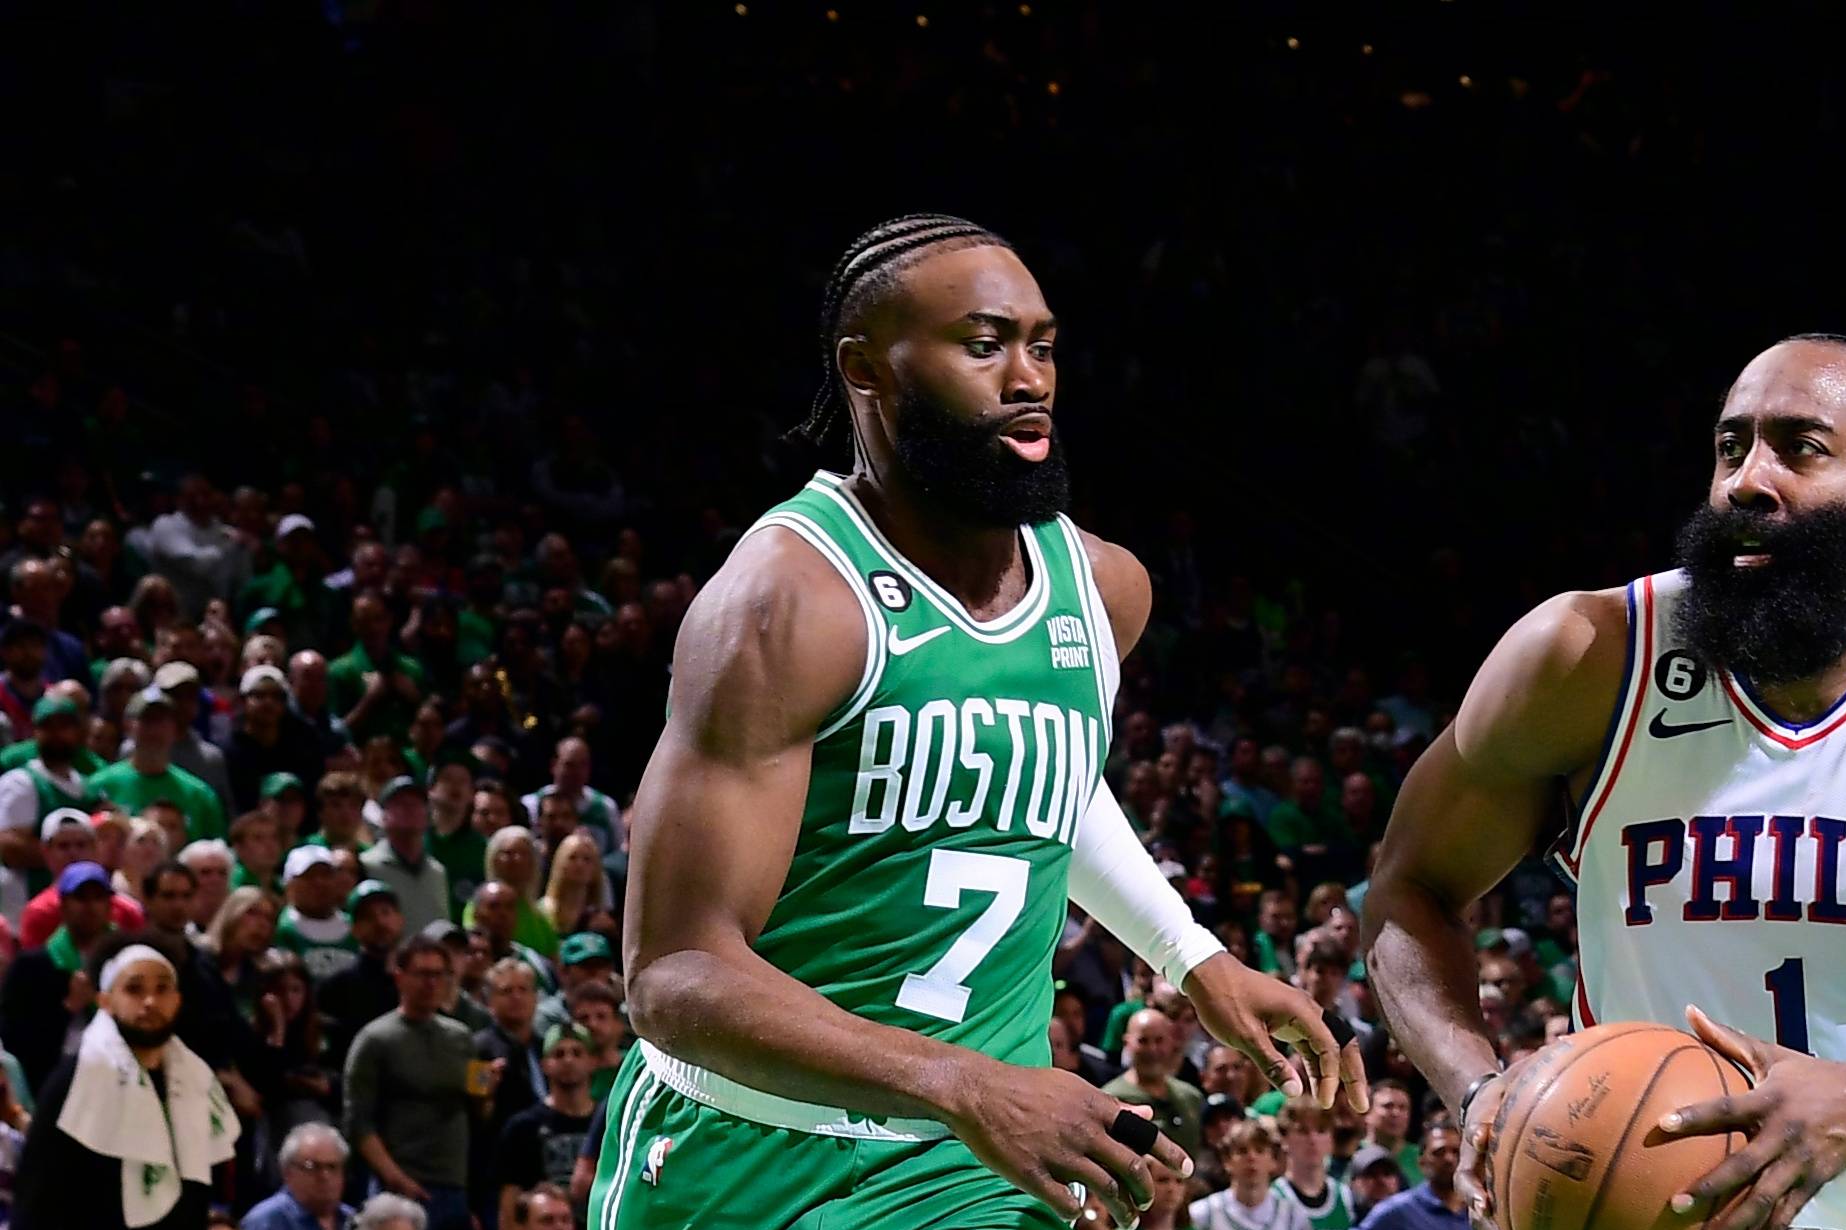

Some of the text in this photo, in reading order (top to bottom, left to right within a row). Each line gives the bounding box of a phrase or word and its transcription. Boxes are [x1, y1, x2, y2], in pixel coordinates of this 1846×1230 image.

[874, 576, 906, 608] 6
[1046, 615, 1088, 645] VISTA
[1051, 646, 1090, 669] PRINT
[1665, 656, 1695, 695] 6
[848, 697, 1098, 849] BOSTON
[895, 848, 1031, 1024] 7
[1764, 956, 1815, 1057] 1
